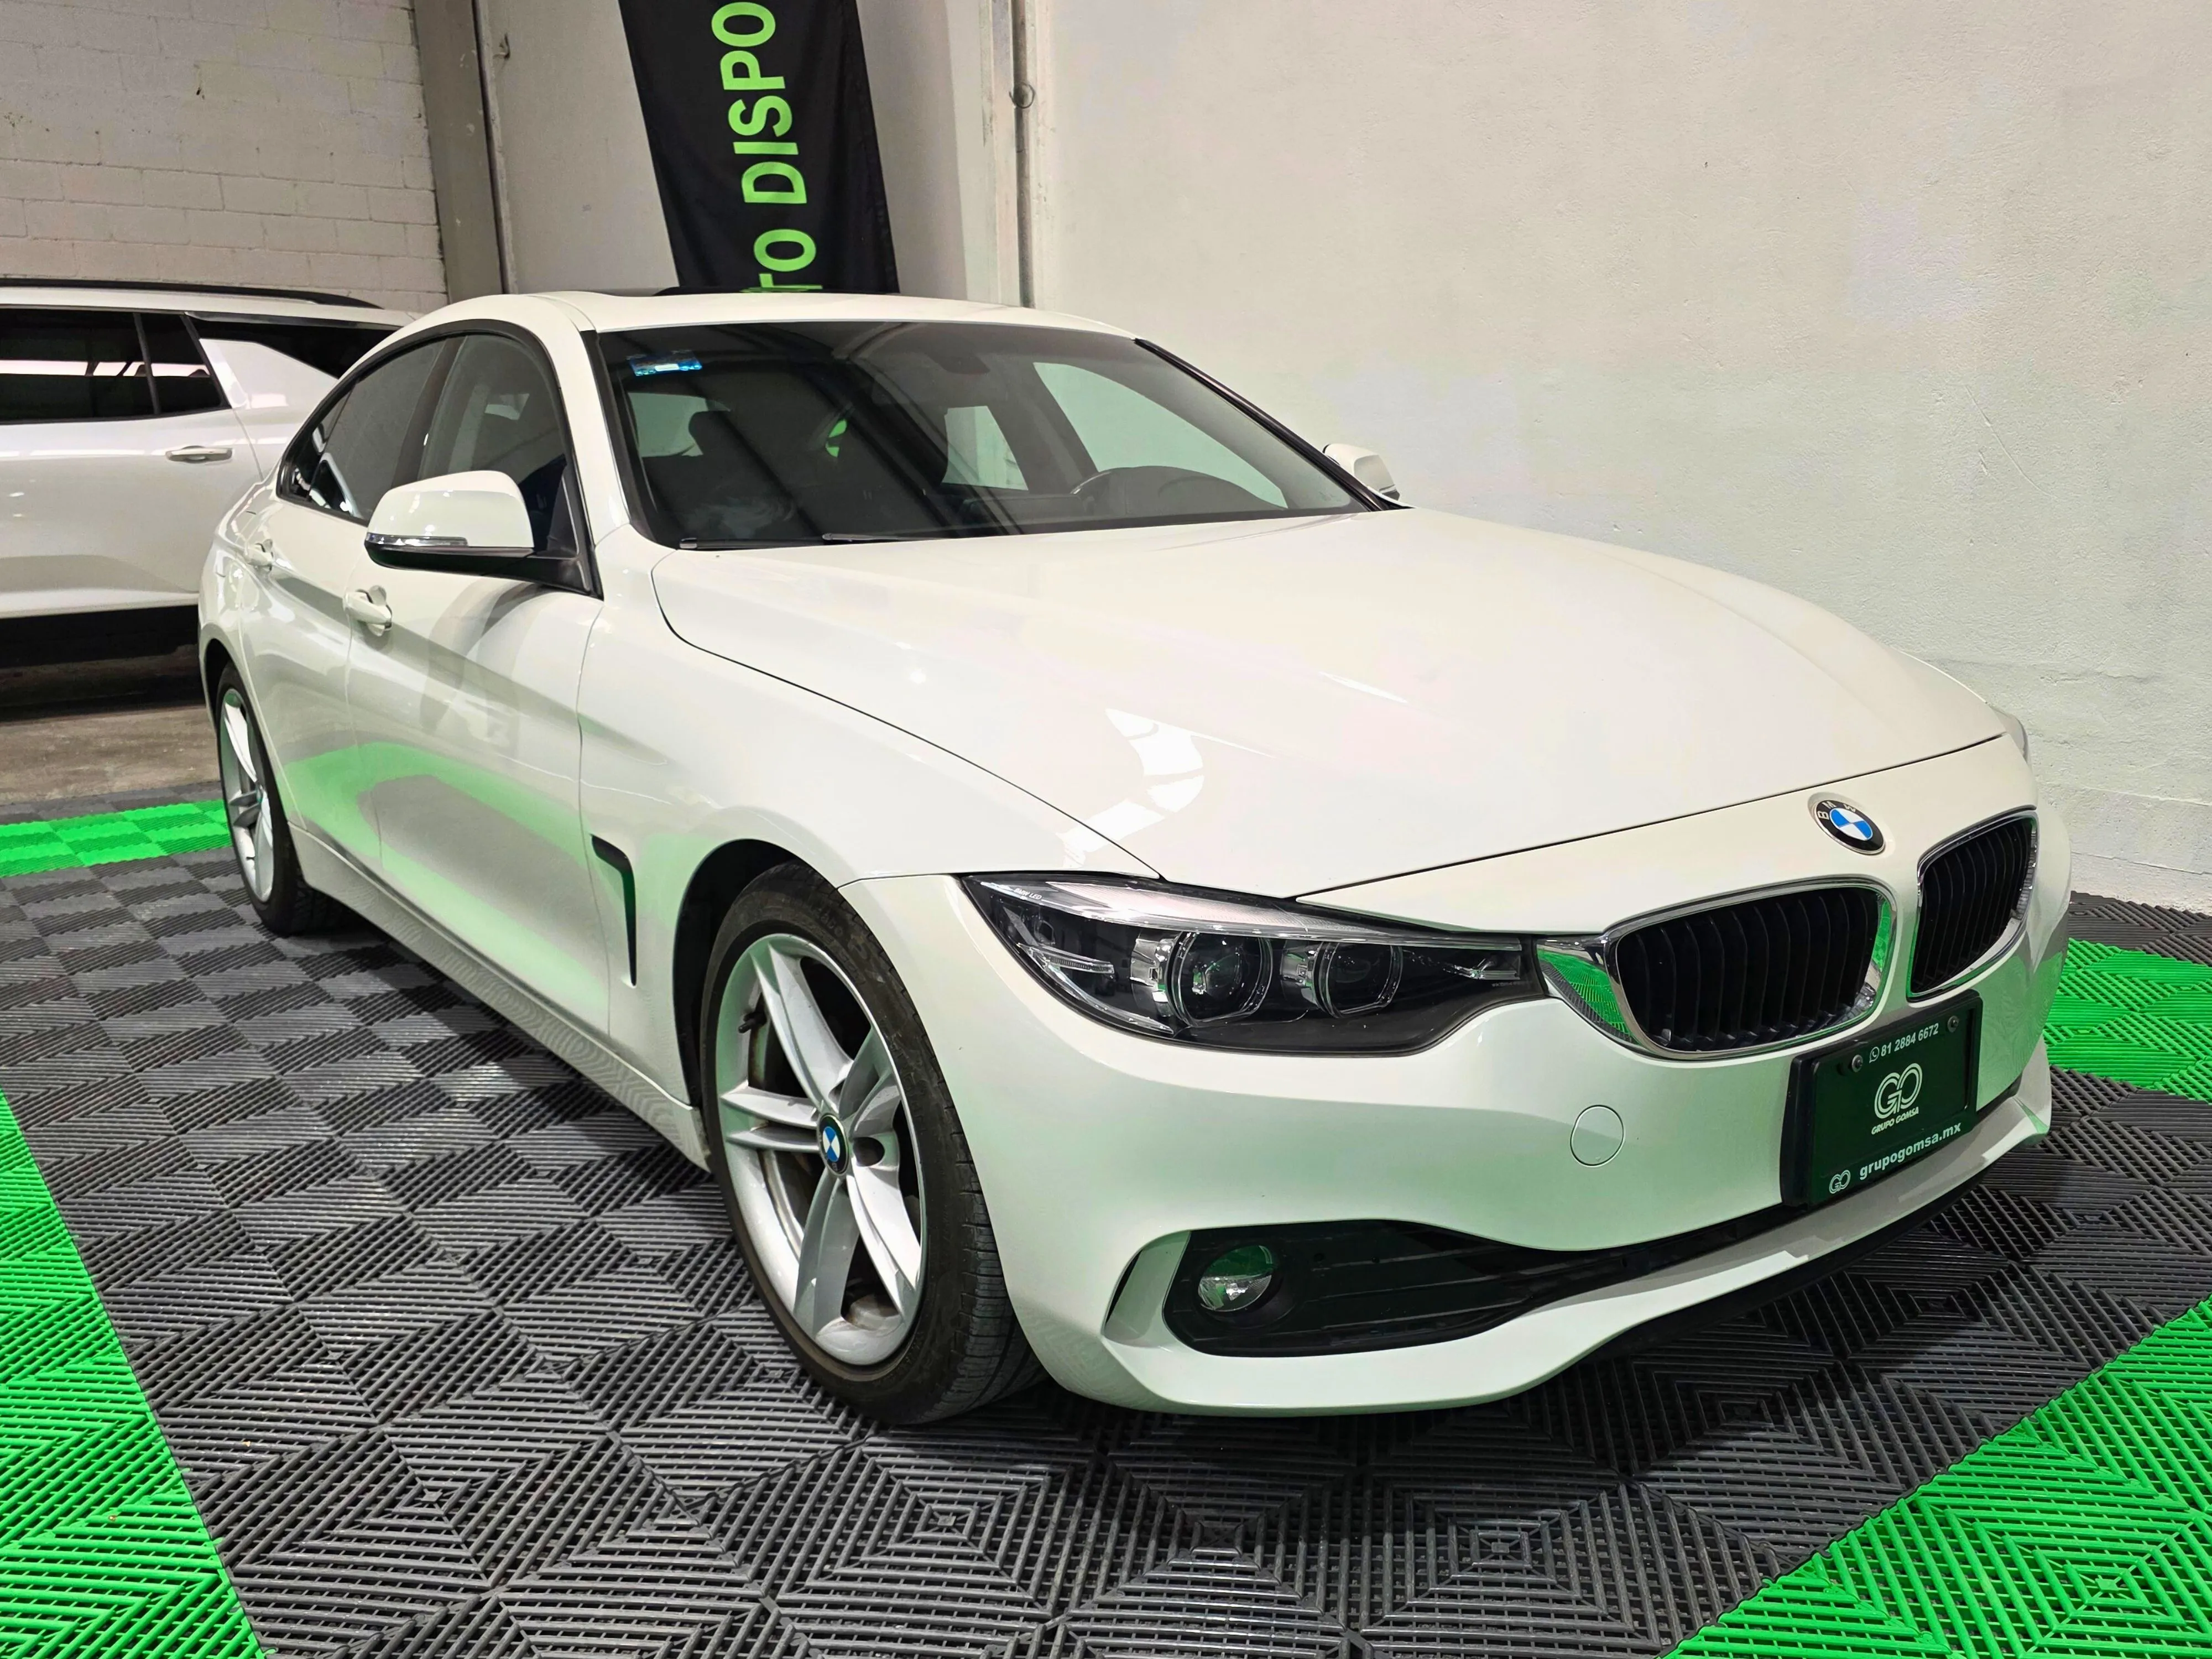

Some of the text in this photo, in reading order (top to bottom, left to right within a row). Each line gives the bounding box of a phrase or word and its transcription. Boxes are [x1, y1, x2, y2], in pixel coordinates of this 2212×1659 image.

[711, 1, 807, 204] DISPO
[1817, 801, 1856, 820] BMW
[1014, 888, 1030, 896] BMW
[1881, 1022, 1939, 1057] 81 2884 6672
[1871, 1107, 1919, 1135] GRUPO GOMSA
[1859, 1123, 1961, 1180] grupogomsa.mx
